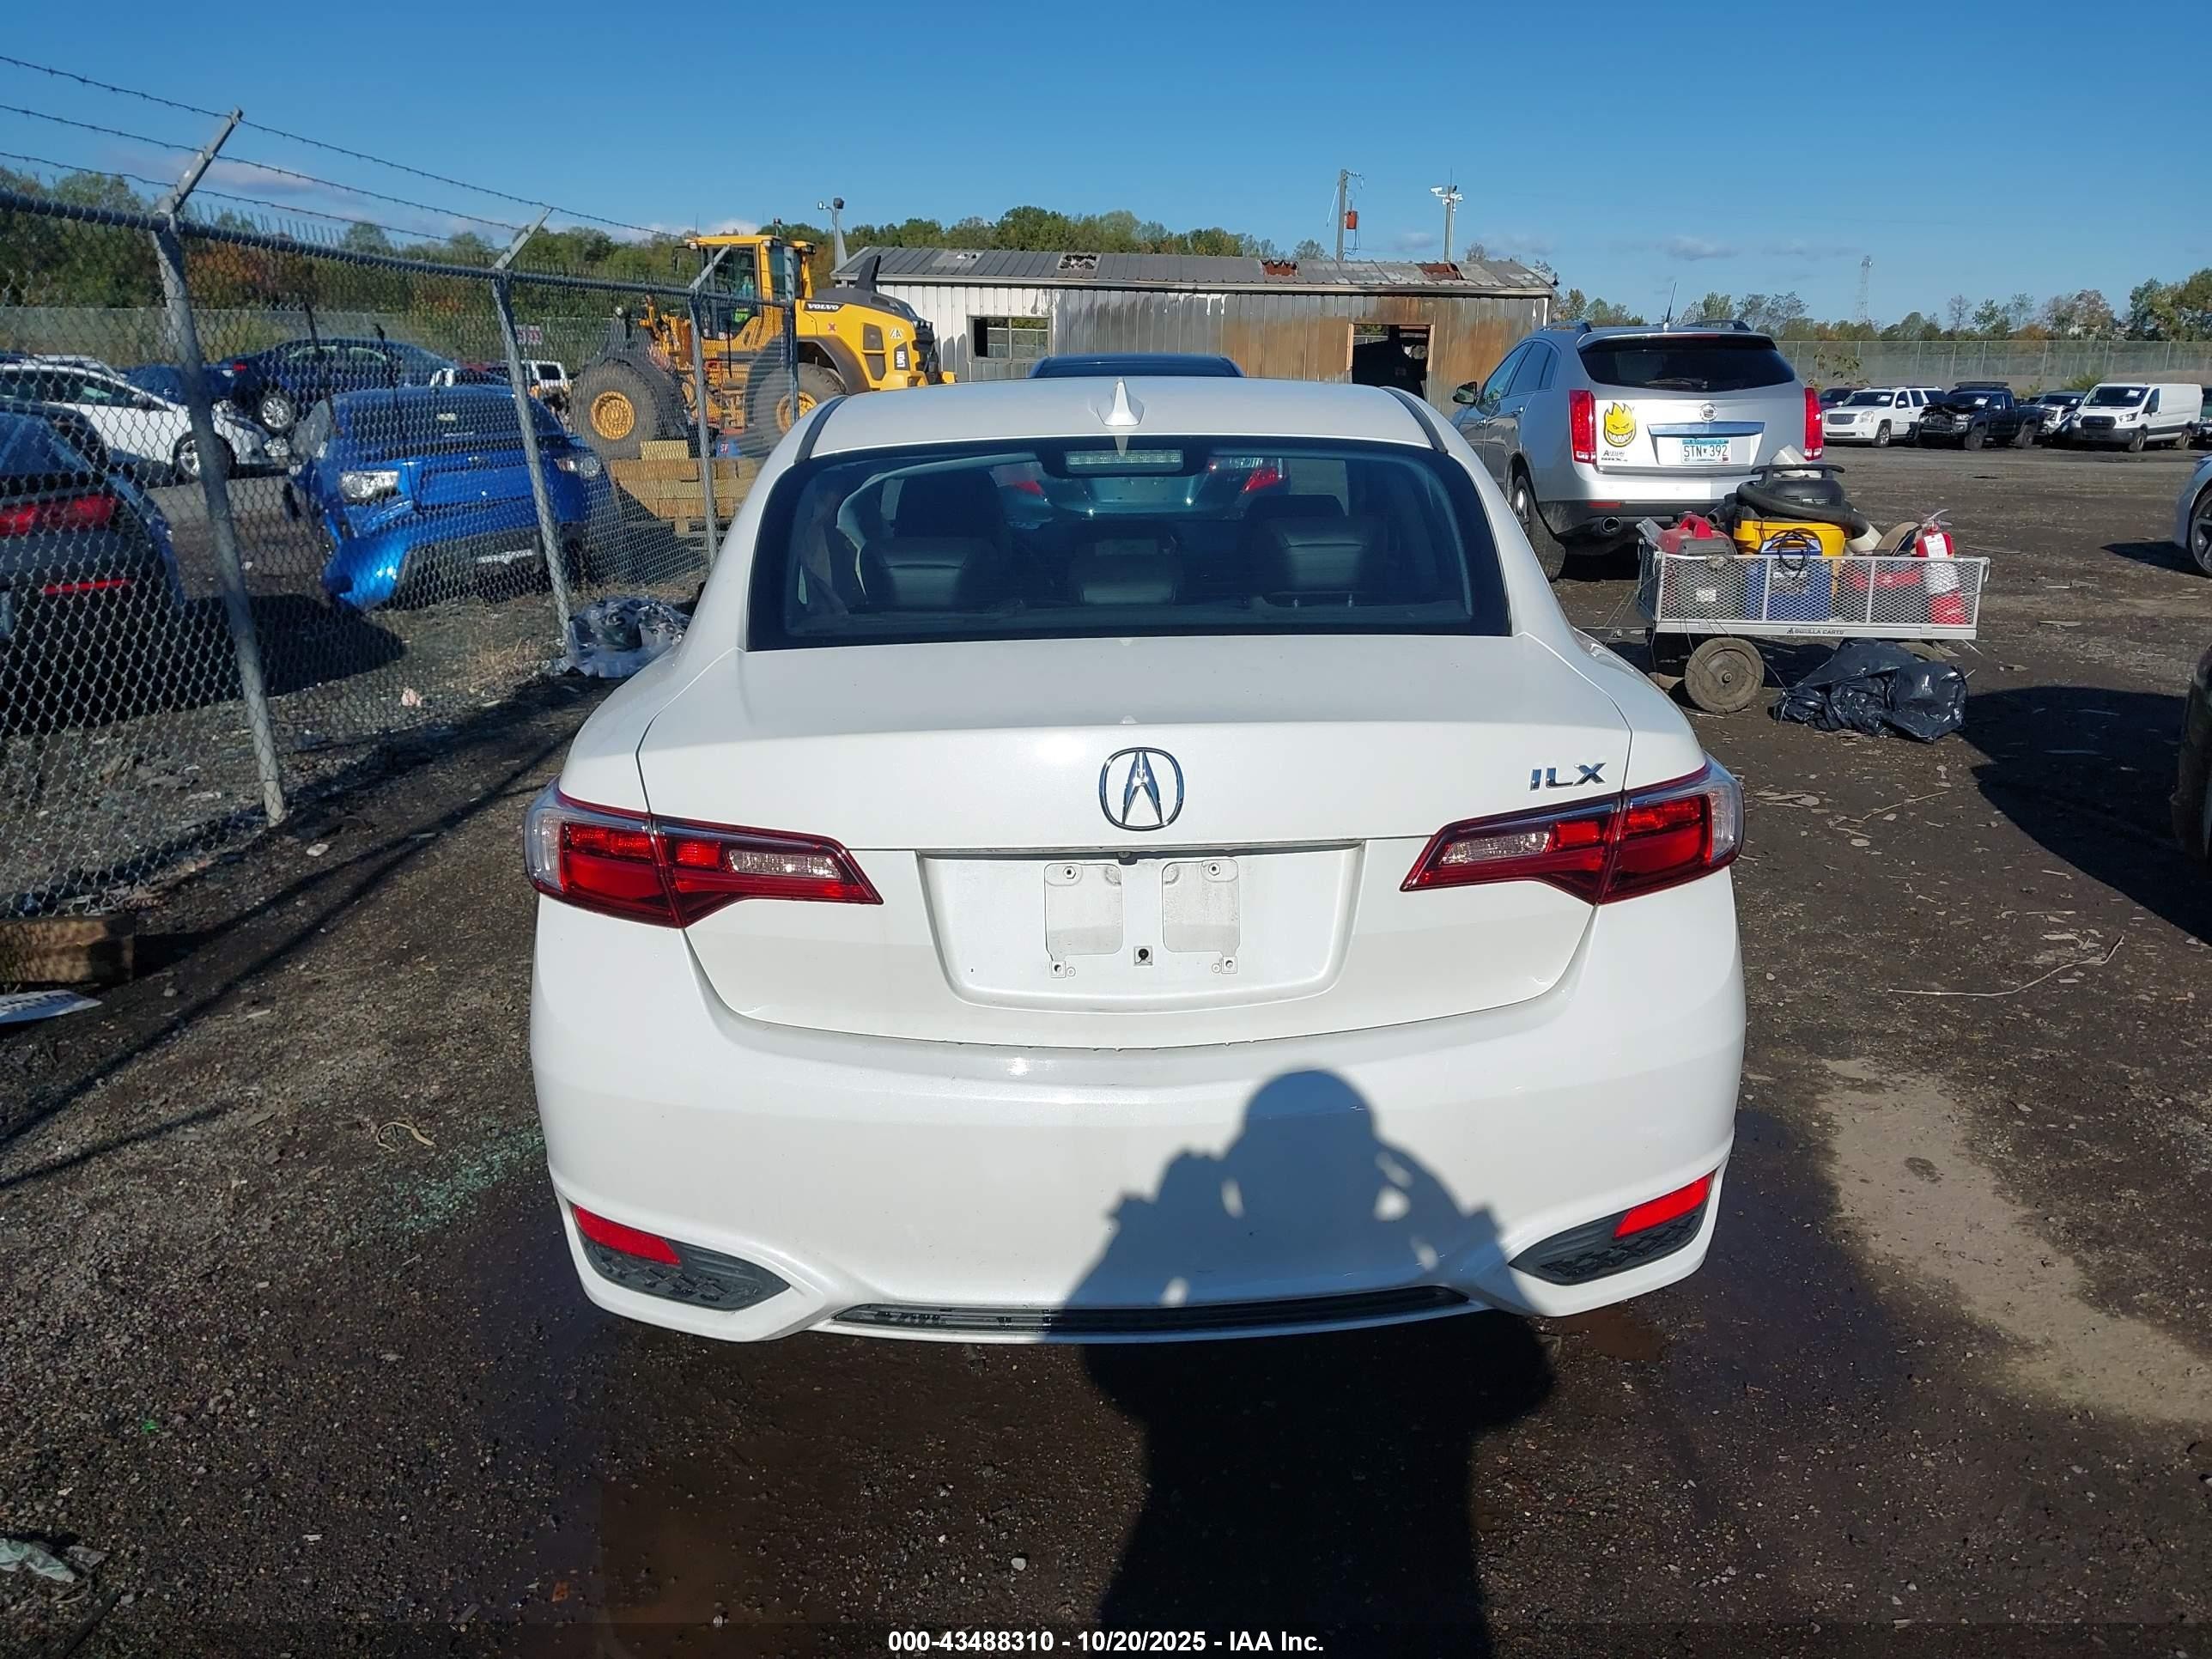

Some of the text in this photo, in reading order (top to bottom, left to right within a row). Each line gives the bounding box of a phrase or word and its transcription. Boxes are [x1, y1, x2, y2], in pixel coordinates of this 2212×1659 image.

[1684, 445, 1728, 458] STN 392
[1529, 762, 1607, 791] ILX
